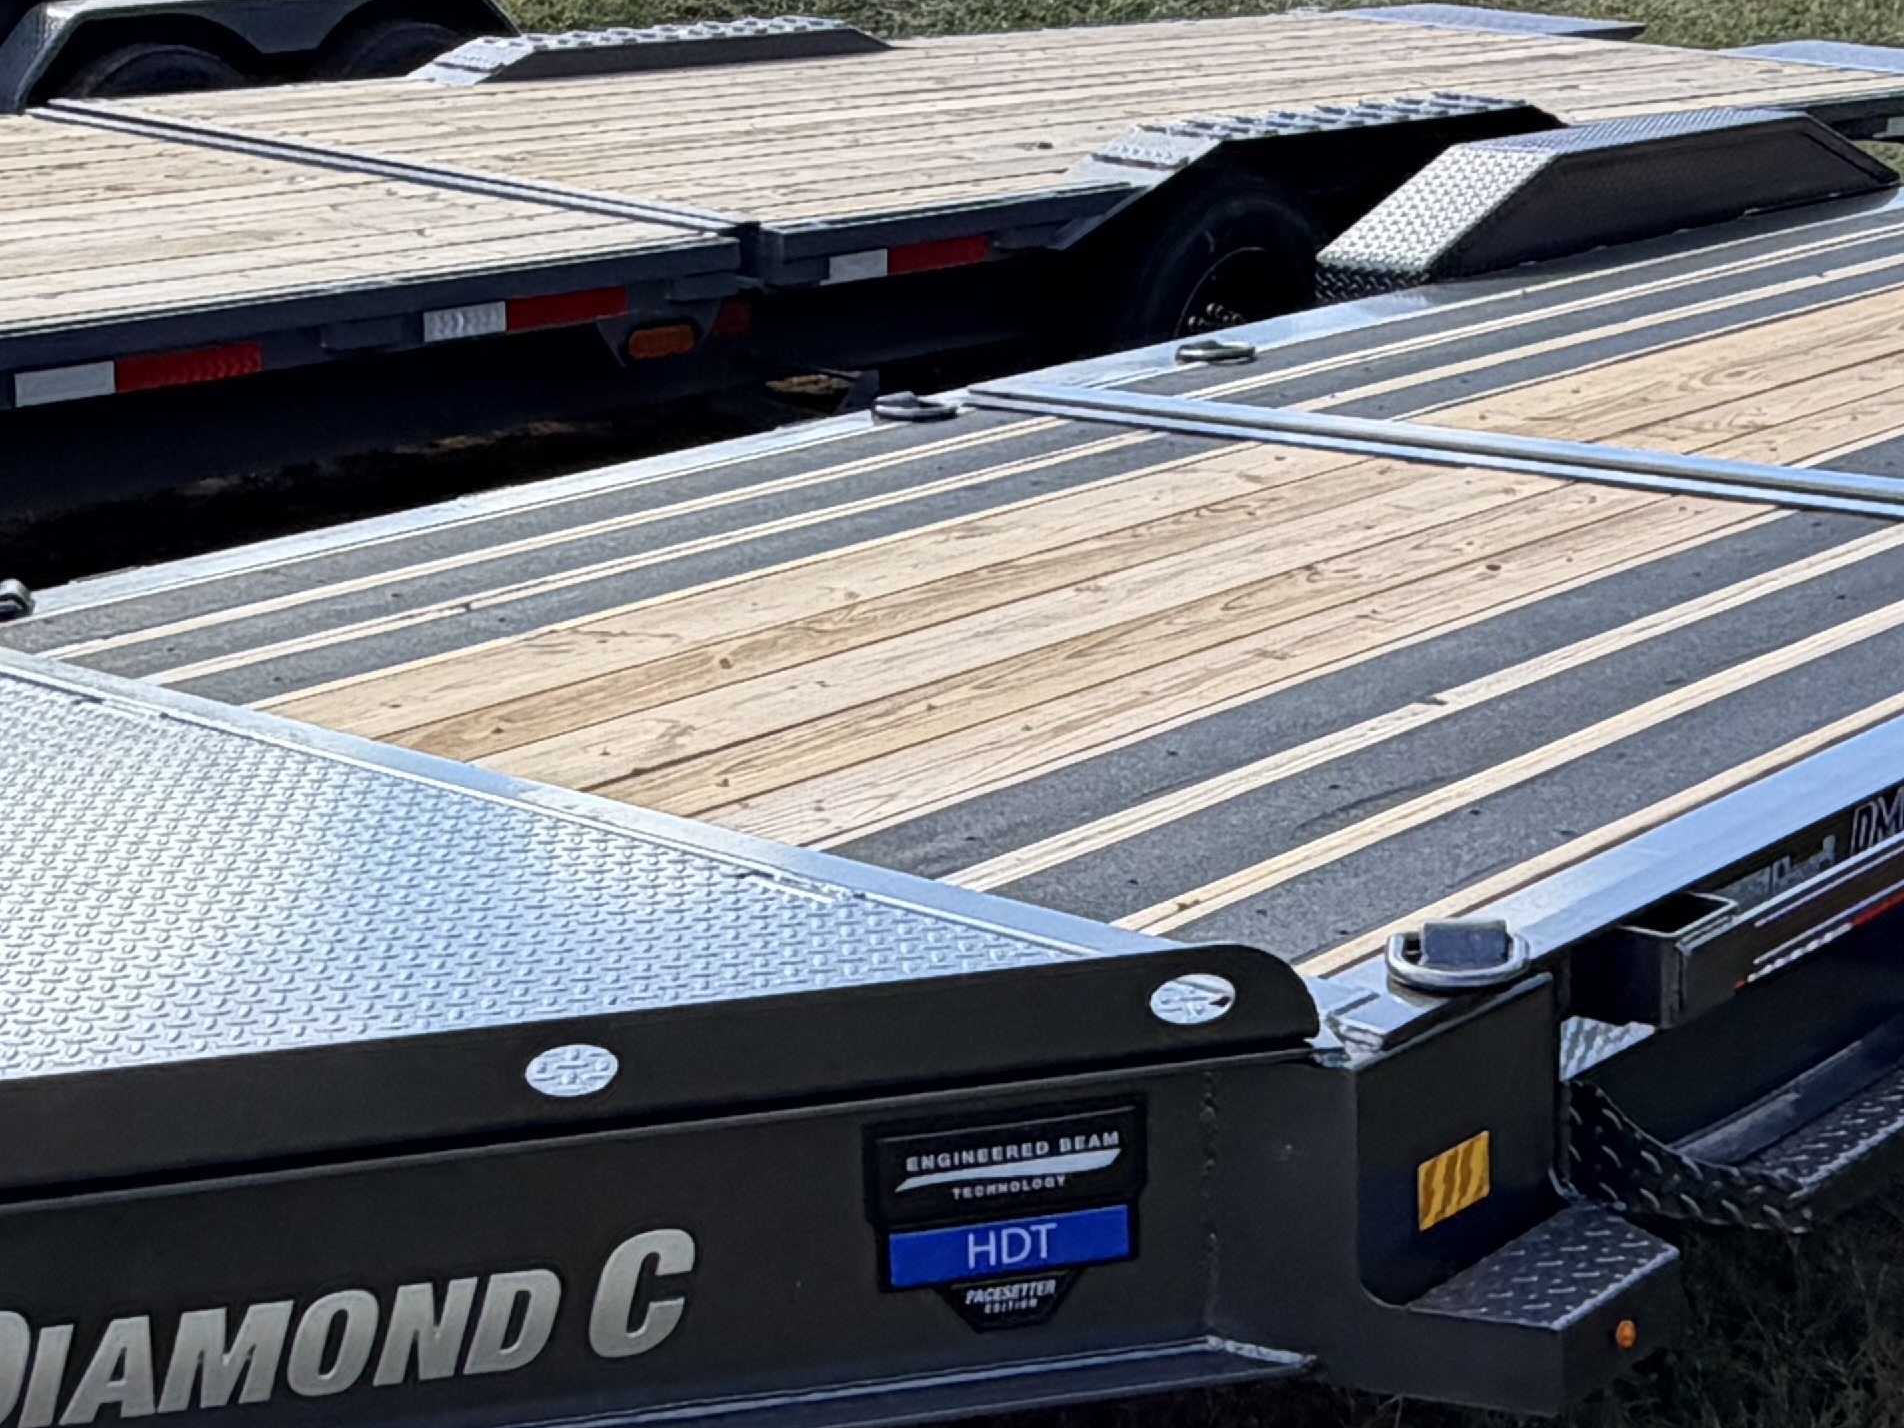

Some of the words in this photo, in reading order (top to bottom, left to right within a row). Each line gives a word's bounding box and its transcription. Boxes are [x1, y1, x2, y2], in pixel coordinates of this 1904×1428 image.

[905, 1140, 1050, 1172] ENGINEERED
[1059, 1130, 1120, 1152] BEAM
[952, 1175, 1067, 1201] TECHNOLOGY
[966, 1222, 1058, 1270] HDT
[588, 1227, 697, 1359] C
[964, 1278, 1057, 1306] PACESETTER
